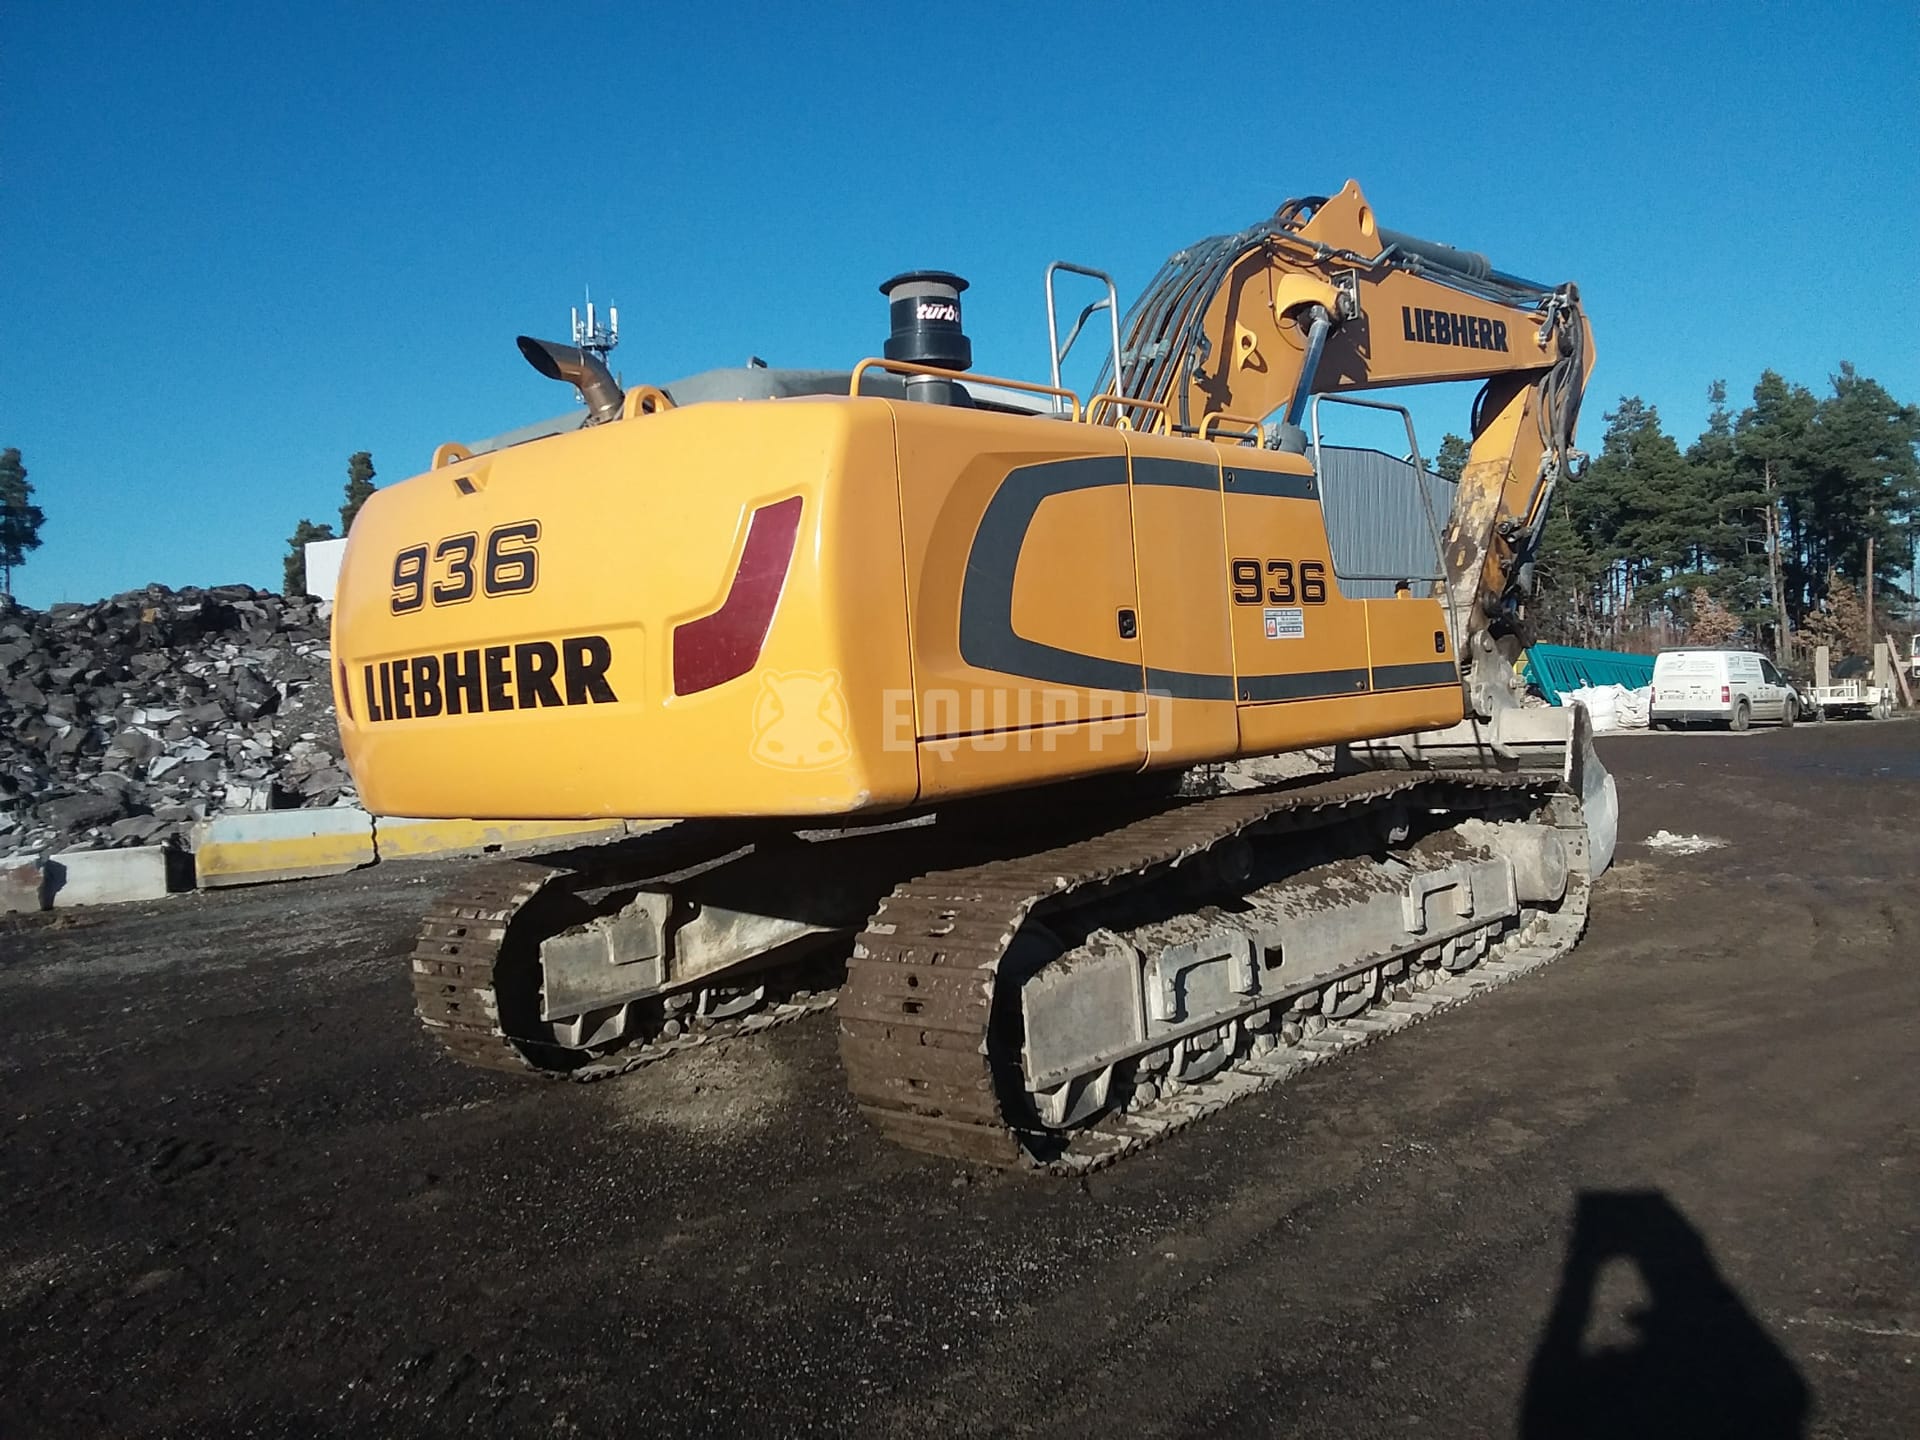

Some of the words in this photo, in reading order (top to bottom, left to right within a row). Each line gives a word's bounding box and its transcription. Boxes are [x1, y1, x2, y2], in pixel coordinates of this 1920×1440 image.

[1402, 306, 1508, 352] LIEBHERR
[391, 519, 541, 616] 936
[1231, 558, 1327, 606] 936
[364, 635, 618, 722] LIEBHERR
